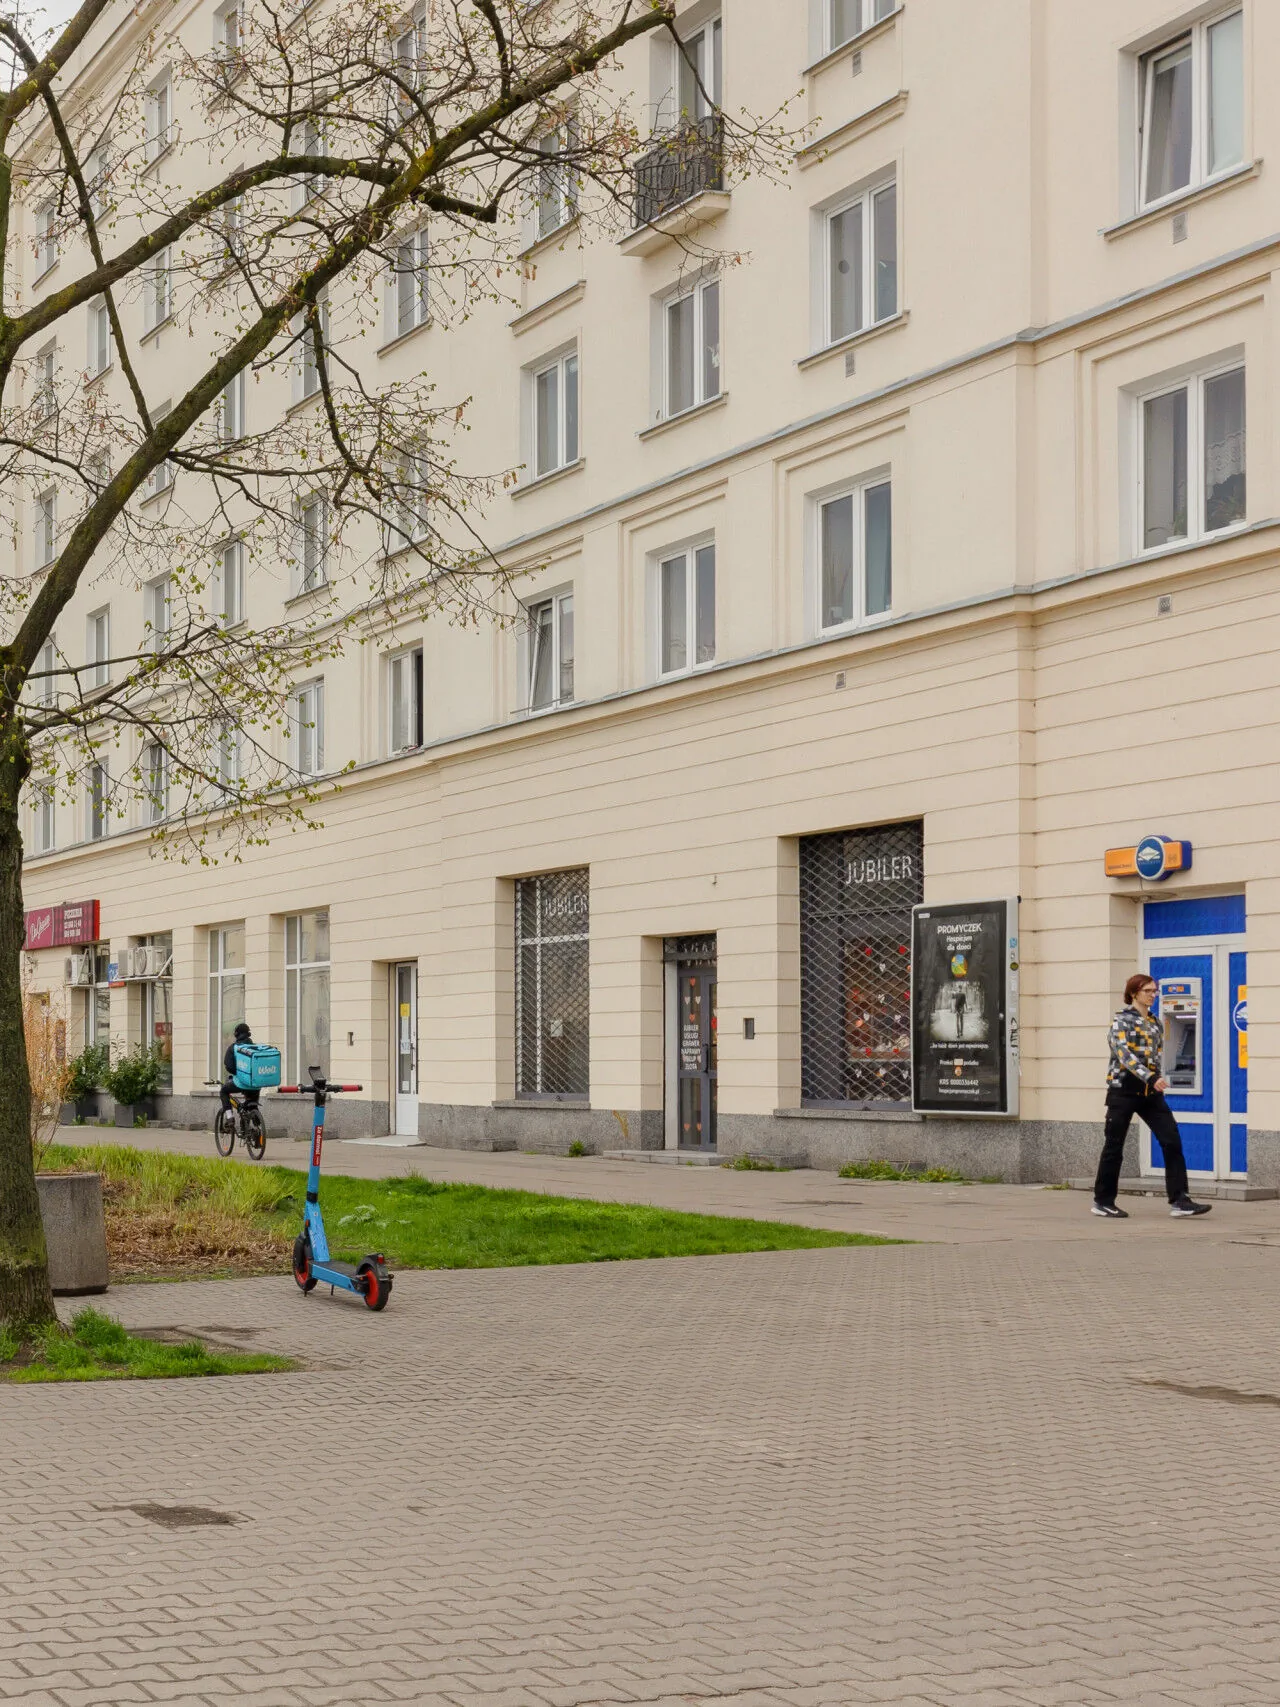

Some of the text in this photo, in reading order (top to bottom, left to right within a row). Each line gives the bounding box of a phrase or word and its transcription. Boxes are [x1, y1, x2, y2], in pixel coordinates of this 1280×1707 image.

[845, 855, 912, 885] JUBILER
[544, 894, 588, 916] JUBILER
[936, 922, 982, 935] PROMYCZEK
[946, 935, 973, 943] Hospicjum
[956, 942, 972, 951] dzieci
